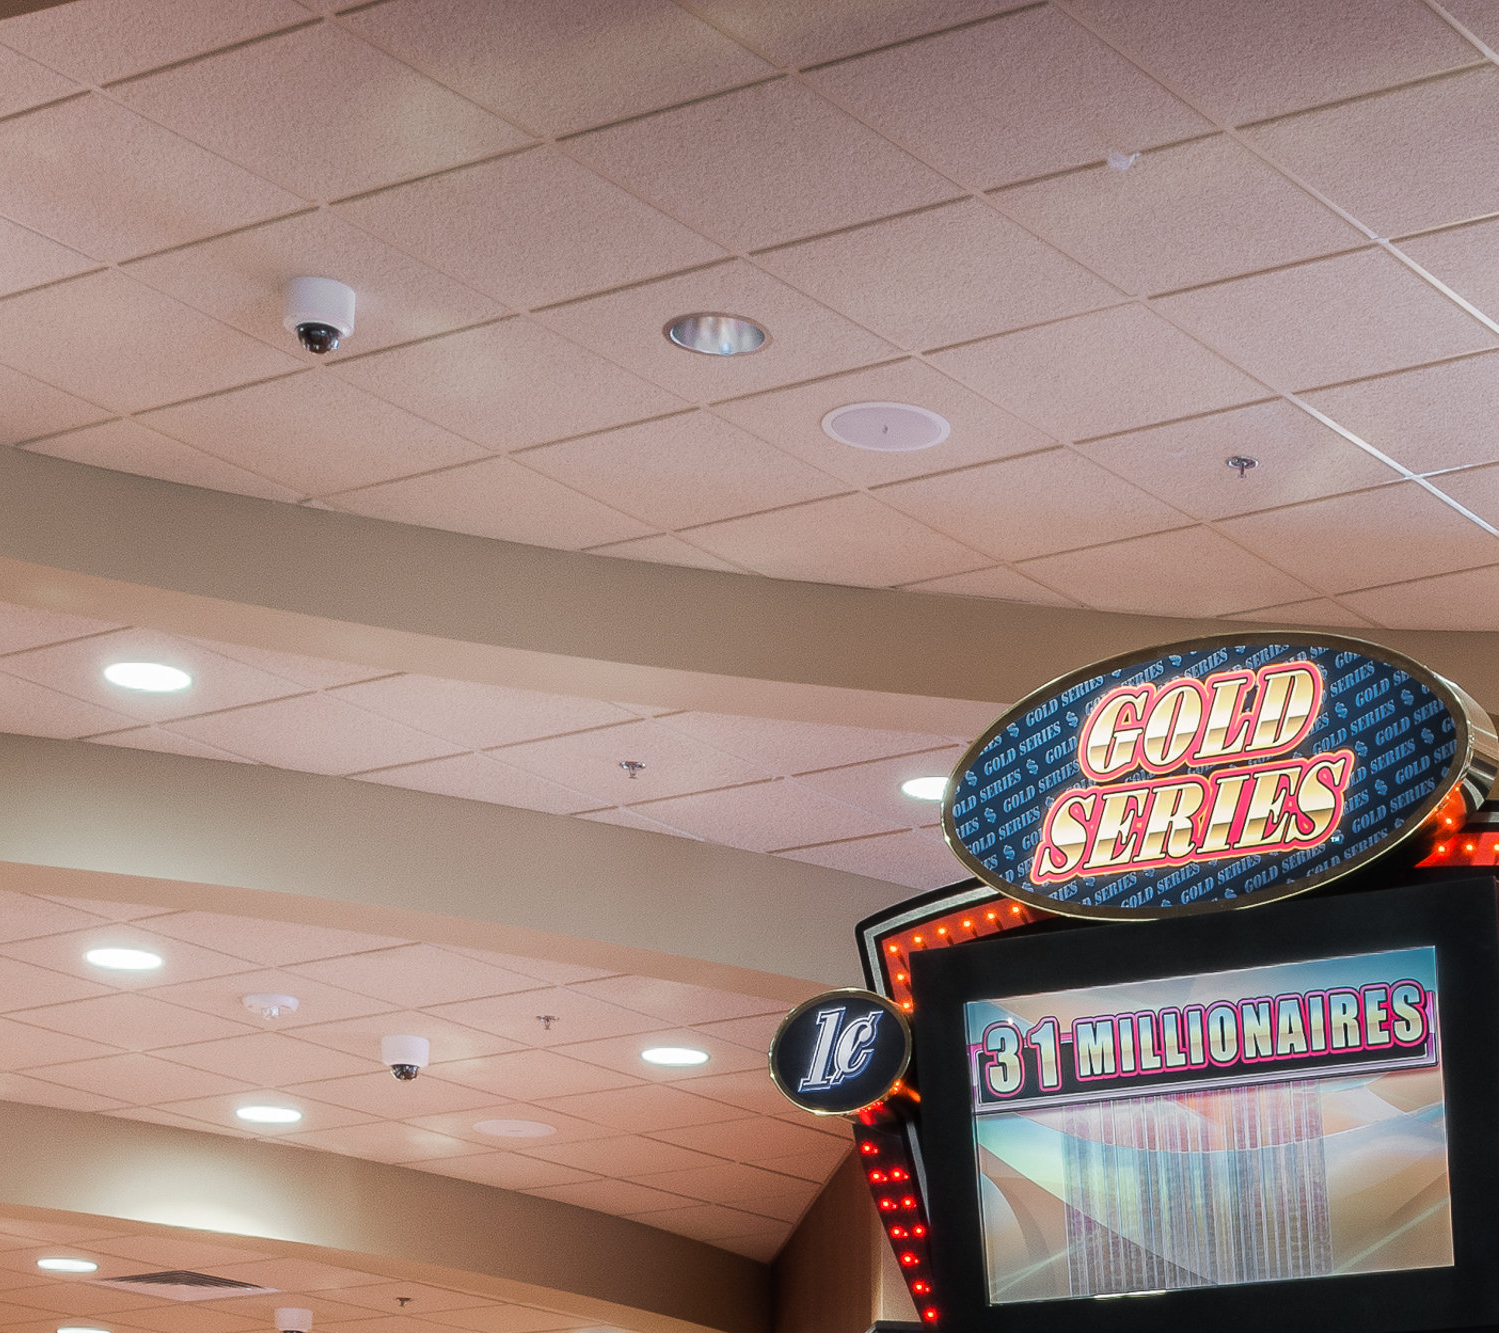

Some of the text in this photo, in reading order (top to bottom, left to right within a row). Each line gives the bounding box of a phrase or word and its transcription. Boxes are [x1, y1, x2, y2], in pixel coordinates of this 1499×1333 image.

[1330, 660, 1375, 698] SERIES
[1355, 678, 1390, 707] GOLD
[1025, 699, 1059, 727] GOLD
[1083, 666, 1318, 778] GOLD
[1350, 700, 1396, 736] SERIES
[984, 748, 1016, 776] GOLD
[1019, 721, 1061, 756] SERIES
[1375, 717, 1410, 747] GOLD
[1045, 736, 1078, 765] GOLD
[1370, 738, 1416, 775] SERIES
[1003, 759, 1080, 814] GOLD SERIES
[1395, 755, 1431, 785] GOLD
[953, 769, 1022, 819] OLD SERIES
[1352, 777, 1436, 834] GOLD SERIES
[998, 806, 1041, 841] SERIES
[1035, 756, 1348, 879] SERIES
[1022, 827, 1043, 851] GOL
[1344, 828, 1388, 859] SERIES
[1157, 862, 1201, 895] SERIES
[1181, 855, 1262, 905] GOLD SERIES
[1244, 867, 1279, 893] GOLD
[798, 1006, 884, 1093] 1¢
[984, 980, 1428, 1097] 31 MILLIONAIRES
